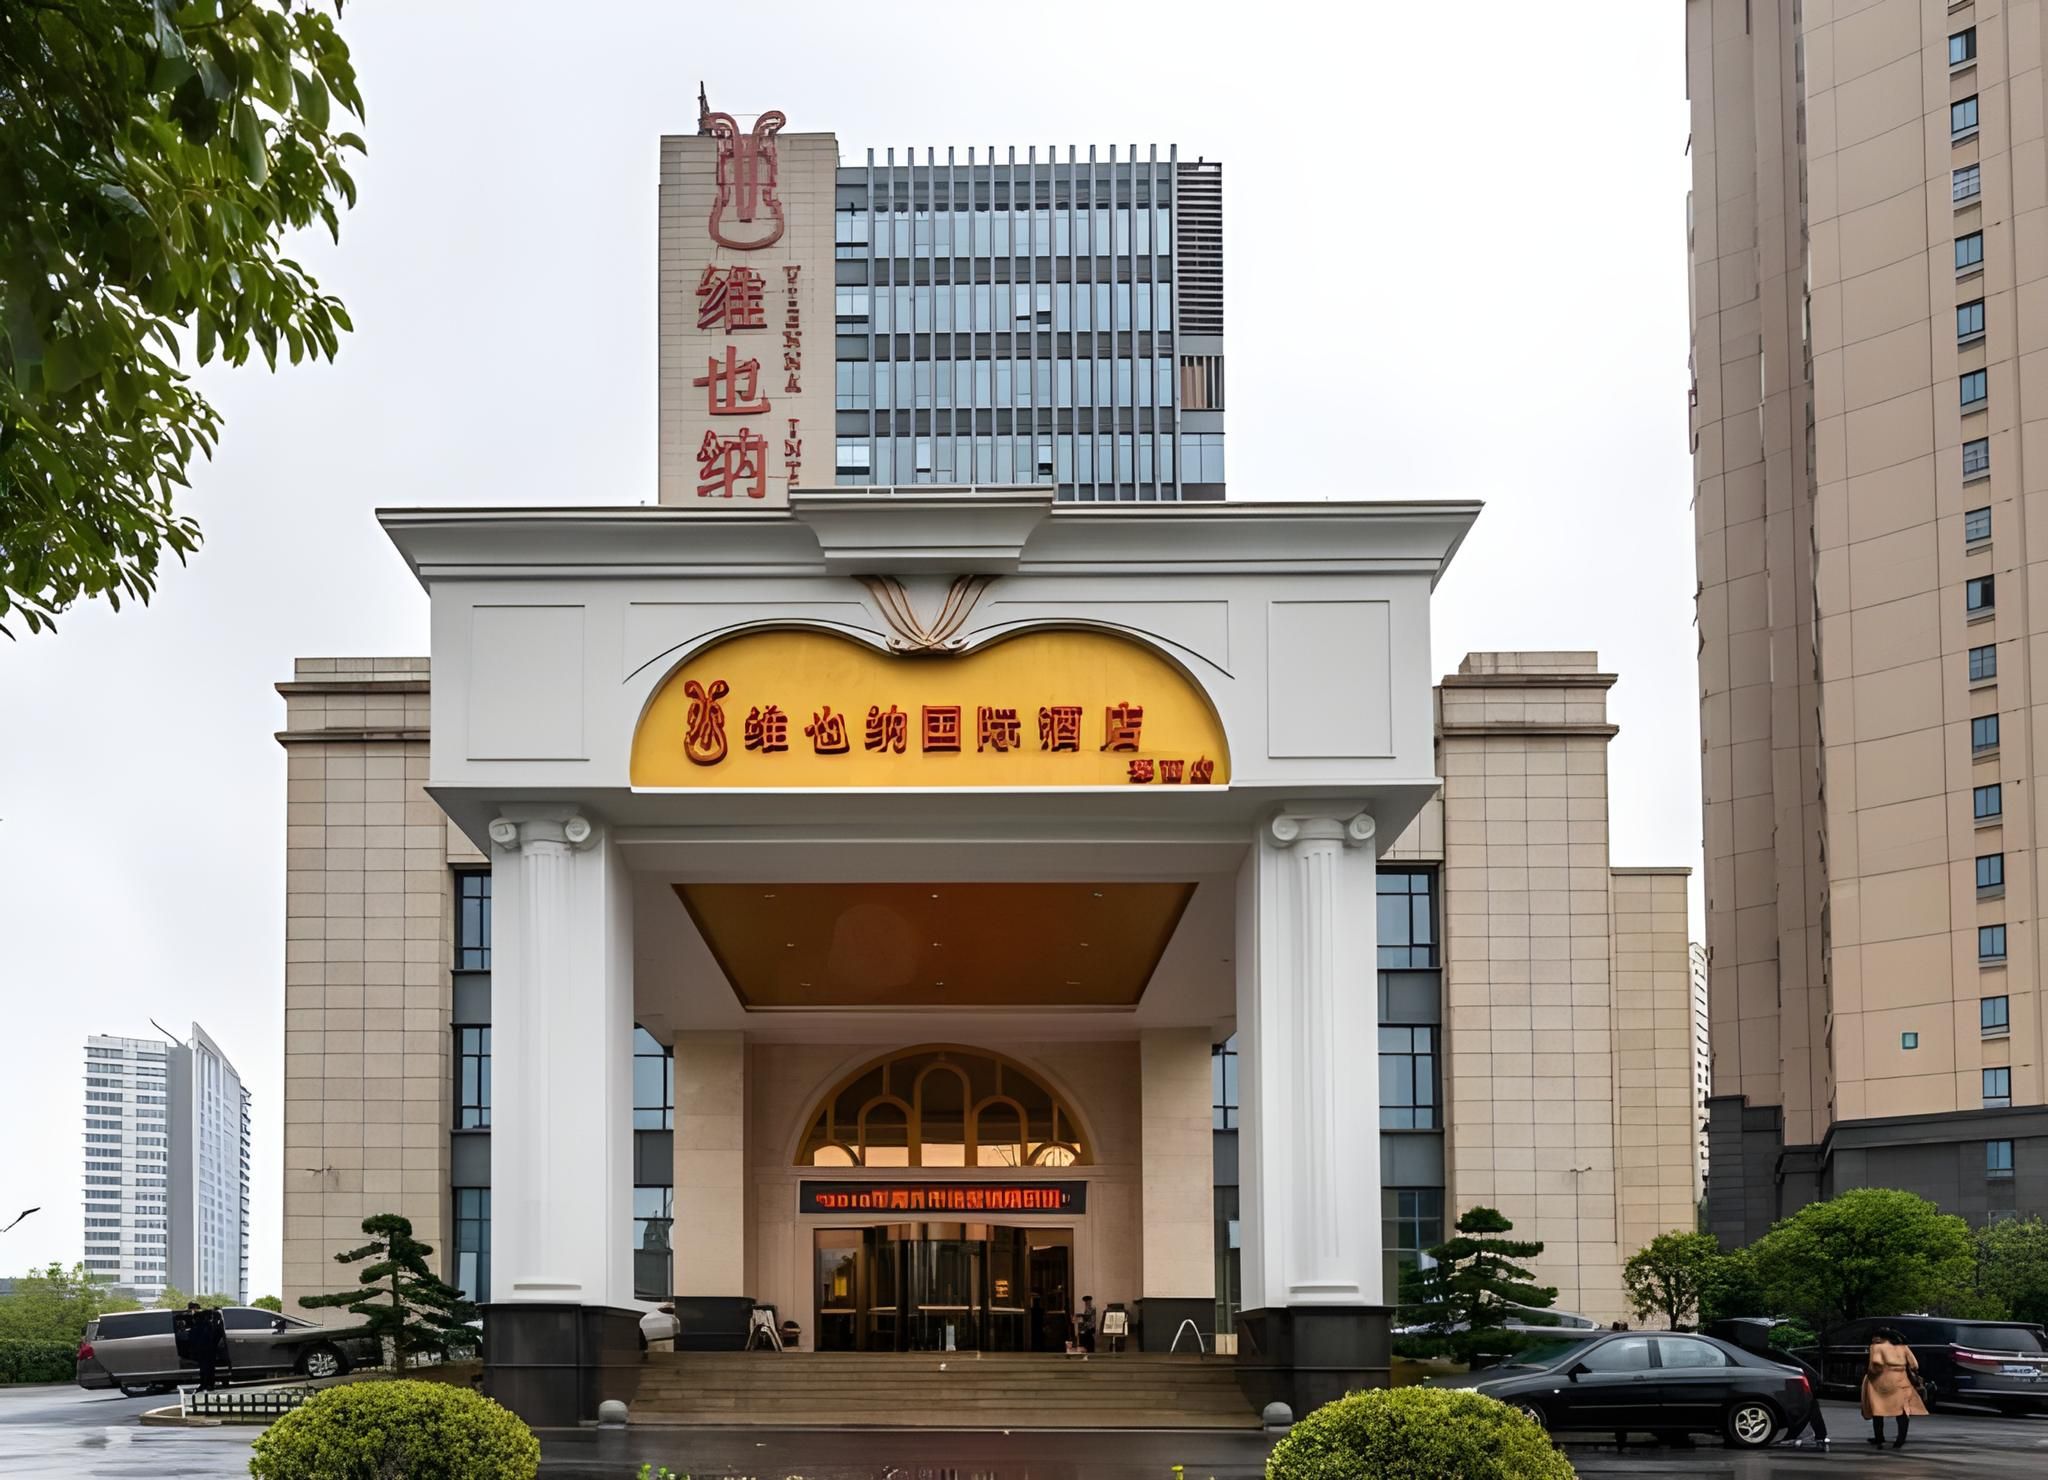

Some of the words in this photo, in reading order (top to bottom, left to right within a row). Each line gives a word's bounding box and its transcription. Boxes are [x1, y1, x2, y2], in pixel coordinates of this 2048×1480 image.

[693, 264, 771, 499] 维也纳
[743, 703, 1144, 754] 维也纳国际酒店
